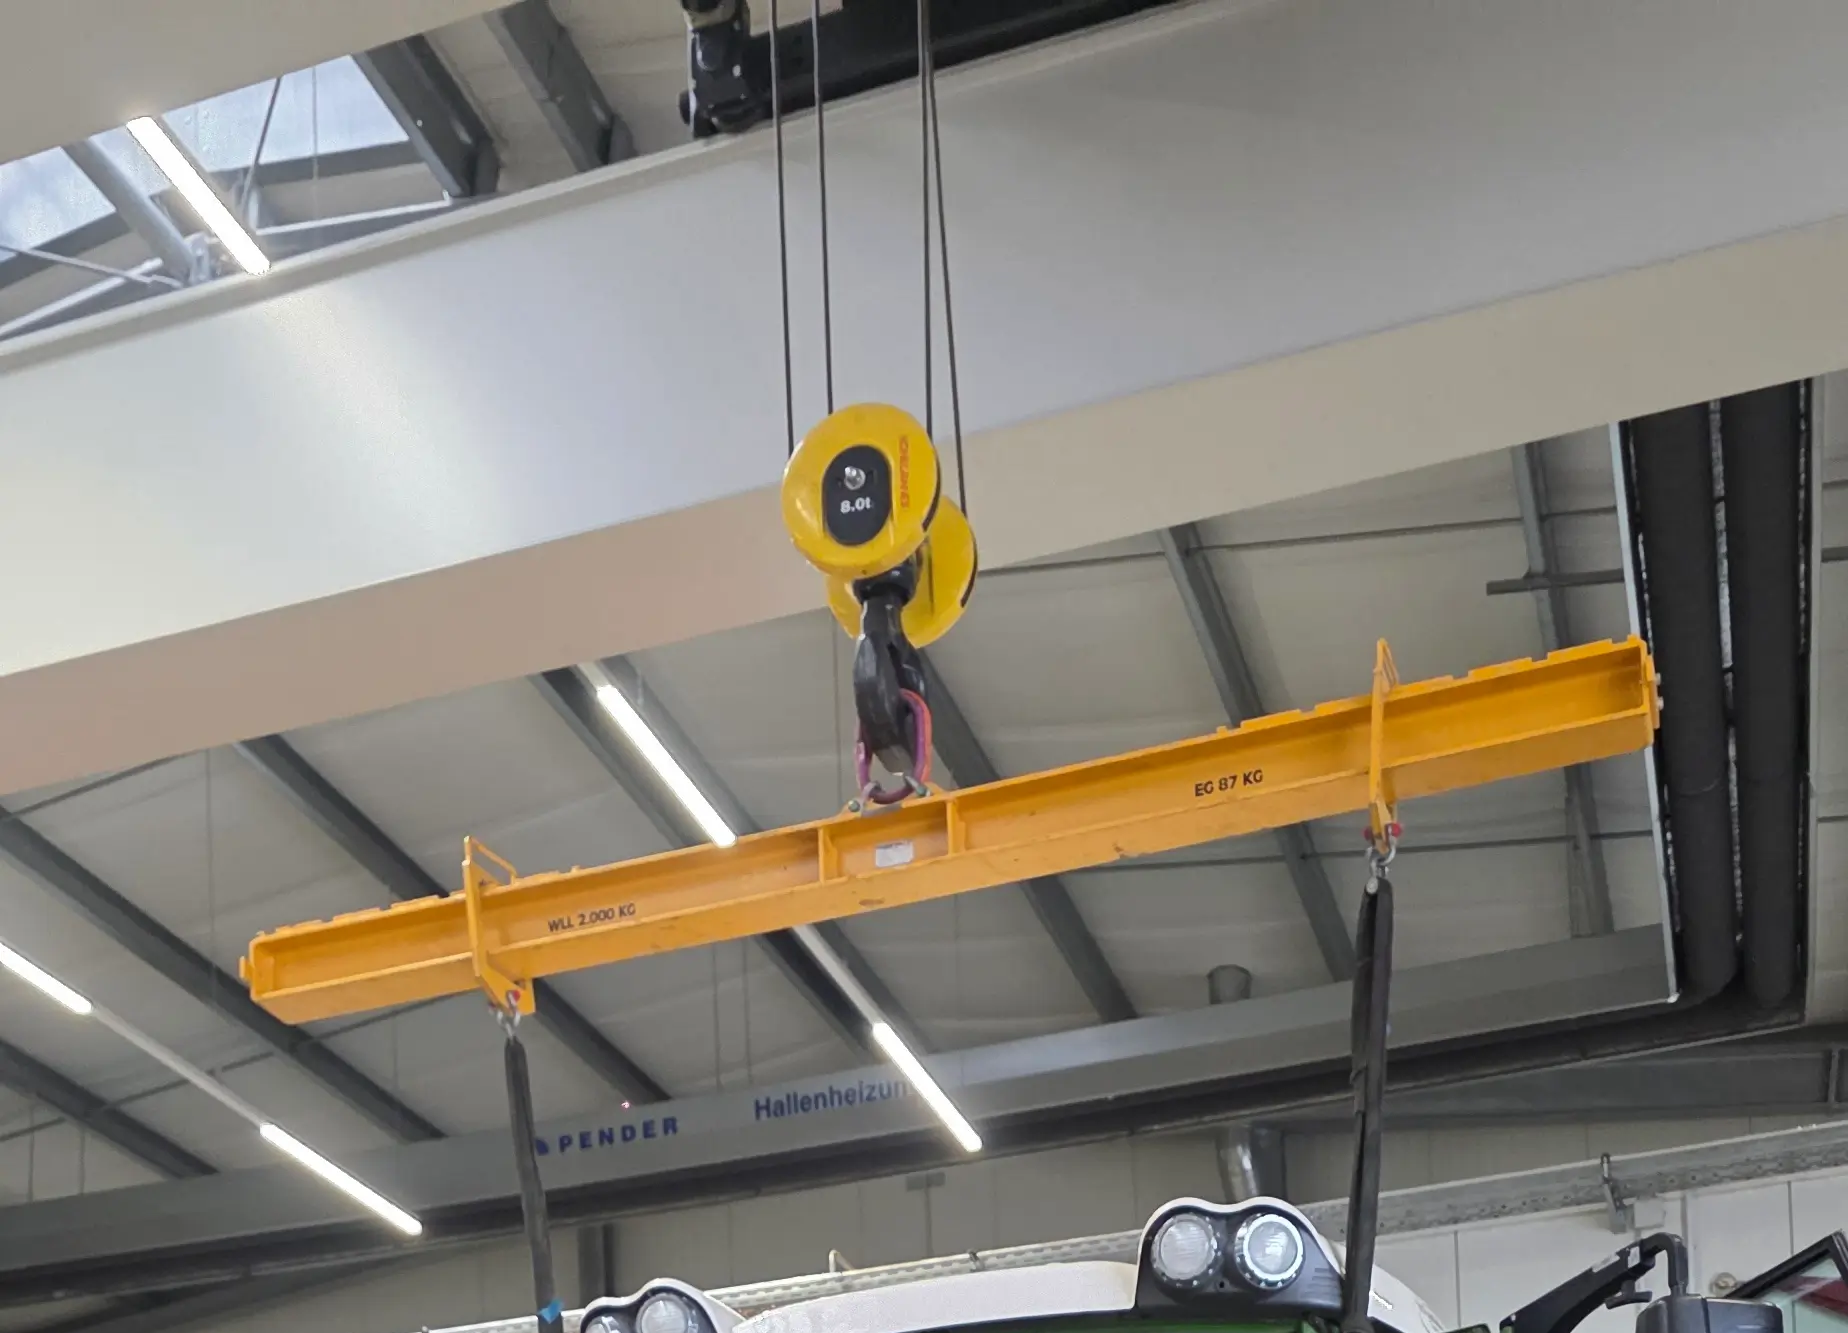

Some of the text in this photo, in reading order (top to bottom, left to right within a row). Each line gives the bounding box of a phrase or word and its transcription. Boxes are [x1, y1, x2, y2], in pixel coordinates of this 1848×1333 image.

[840, 497, 871, 513] 8.0t
[1195, 769, 1263, 797] EG 87 KG
[547, 916, 574, 932] WLL
[578, 907, 615, 926] 2.000
[559, 1080, 908, 1153] PENDER Hallenheizun
